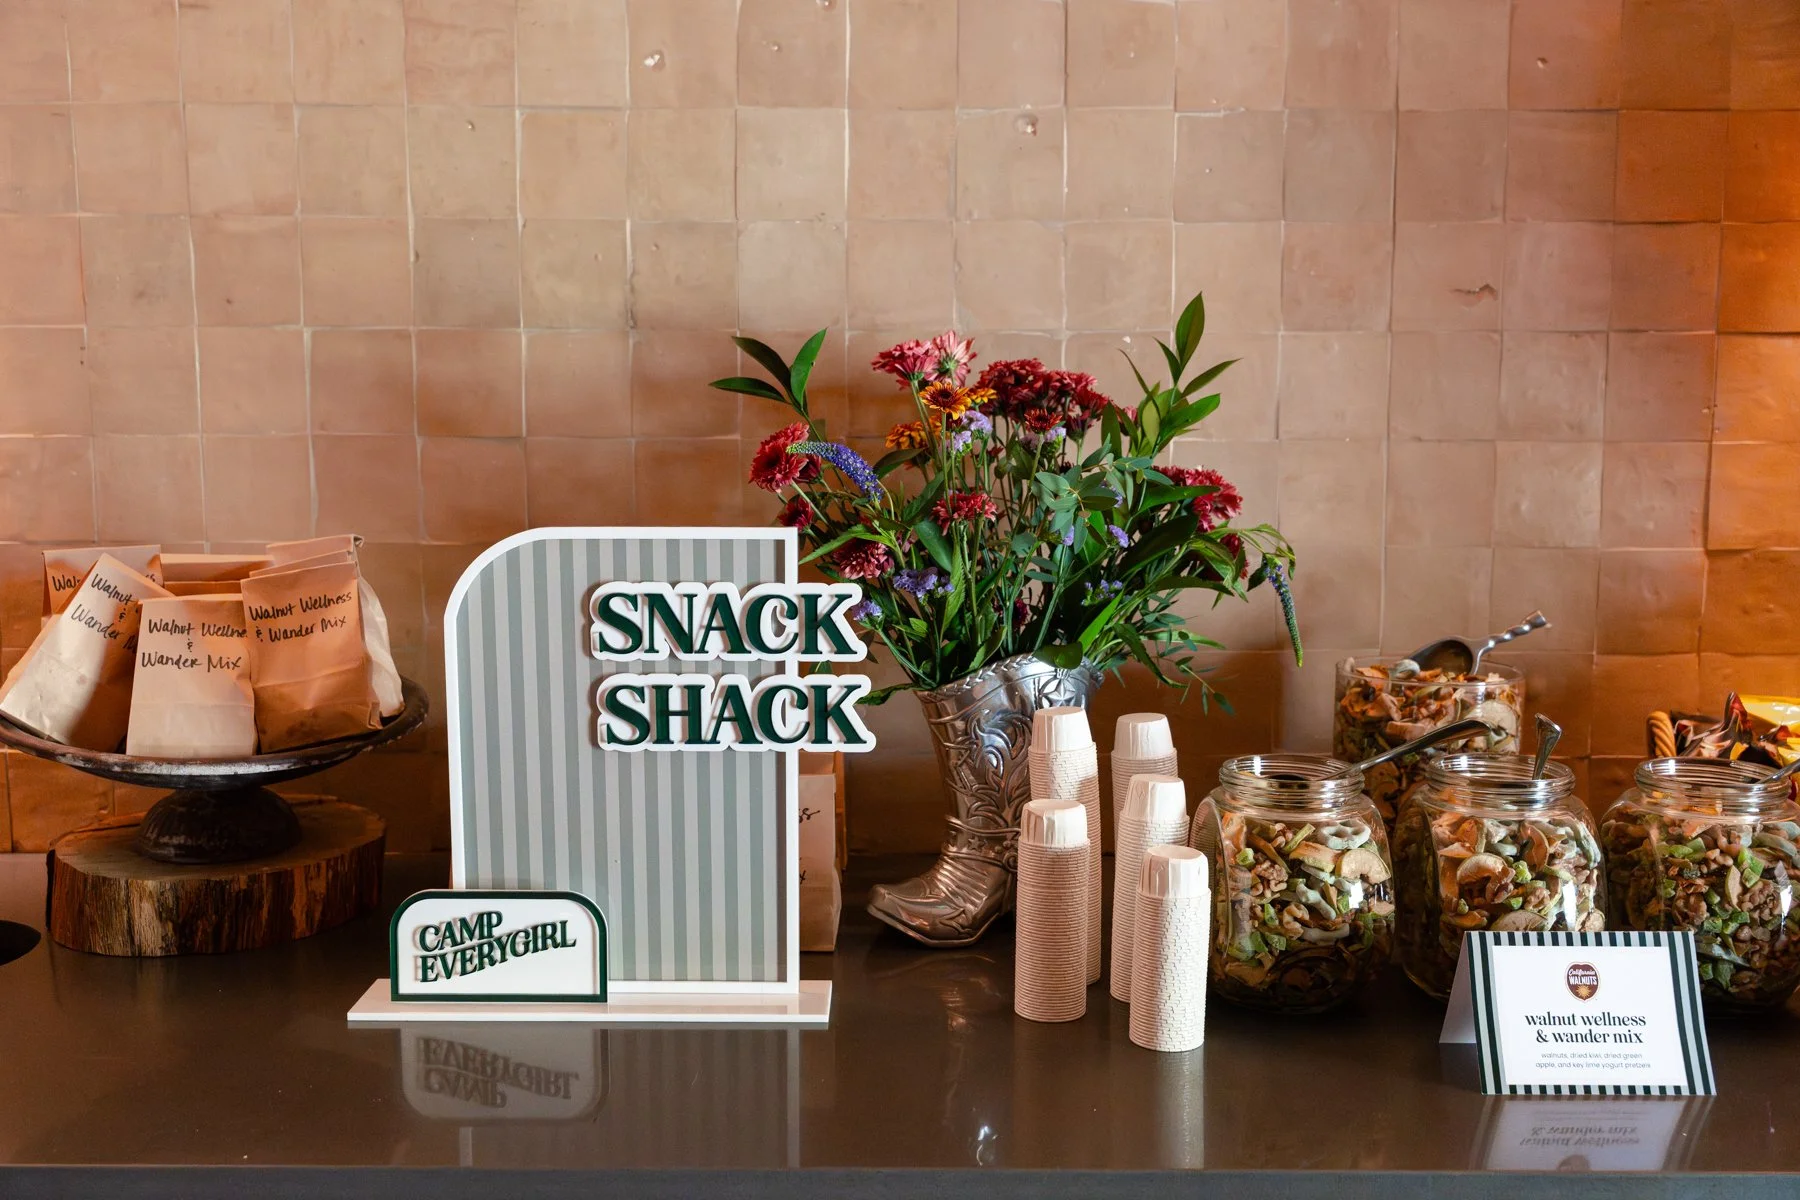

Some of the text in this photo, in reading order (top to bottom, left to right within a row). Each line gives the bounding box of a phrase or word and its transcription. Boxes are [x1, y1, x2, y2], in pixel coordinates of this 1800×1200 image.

[52, 574, 80, 592] Wal
[91, 573, 135, 605] Walnut
[248, 592, 352, 622] Walnut Wellness
[70, 604, 123, 640] Wander
[148, 618, 248, 638] Walnut Wellne
[268, 623, 316, 643] Wander
[320, 616, 347, 632] Mix
[598, 592, 858, 655] SNACK
[141, 651, 242, 673] Wander Mix
[605, 684, 867, 746] SHACK
[419, 911, 503, 952] CAMP
[420, 920, 577, 983] EVERYGIRL
[1568, 975, 1598, 986] WALNUTS
[1524, 1011, 1647, 1027] walnut wellness
[1536, 1028, 1644, 1044] & wander mix
[1541, 1051, 1569, 1060] walnuts,
[1570, 1051, 1588, 1059] dried
[1603, 1051, 1622, 1059] dried
[1622, 1052, 1643, 1061] green
[1557, 1060, 1572, 1069] and
[1572, 1060, 1585, 1070] key
[1601, 1061, 1624, 1070] yogurt
